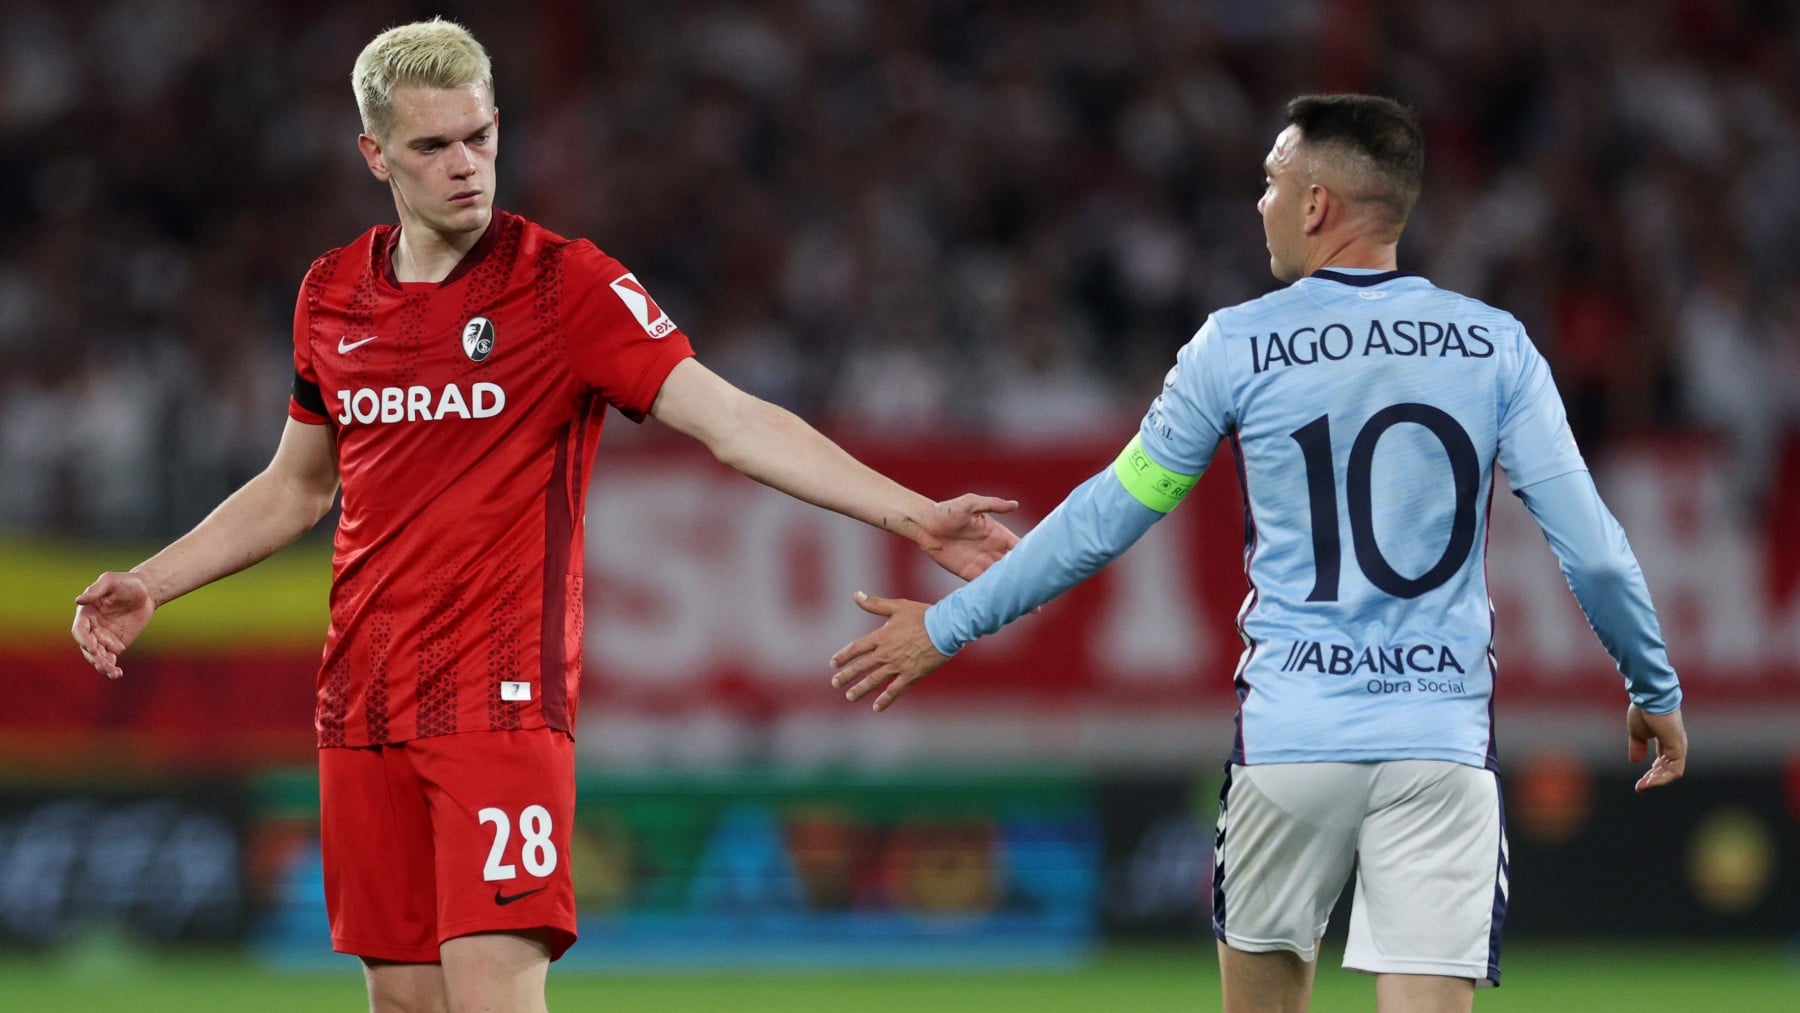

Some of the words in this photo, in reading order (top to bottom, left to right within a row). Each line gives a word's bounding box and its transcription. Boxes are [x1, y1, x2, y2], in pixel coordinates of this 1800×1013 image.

[1251, 323, 1353, 373] IAGO
[1362, 319, 1495, 359] ASPAS
[337, 382, 506, 426] JOBRAD
[1290, 402, 1480, 602] 10
[1366, 679, 1412, 695] Obra
[1417, 679, 1466, 695] Social
[478, 804, 558, 882] 28
